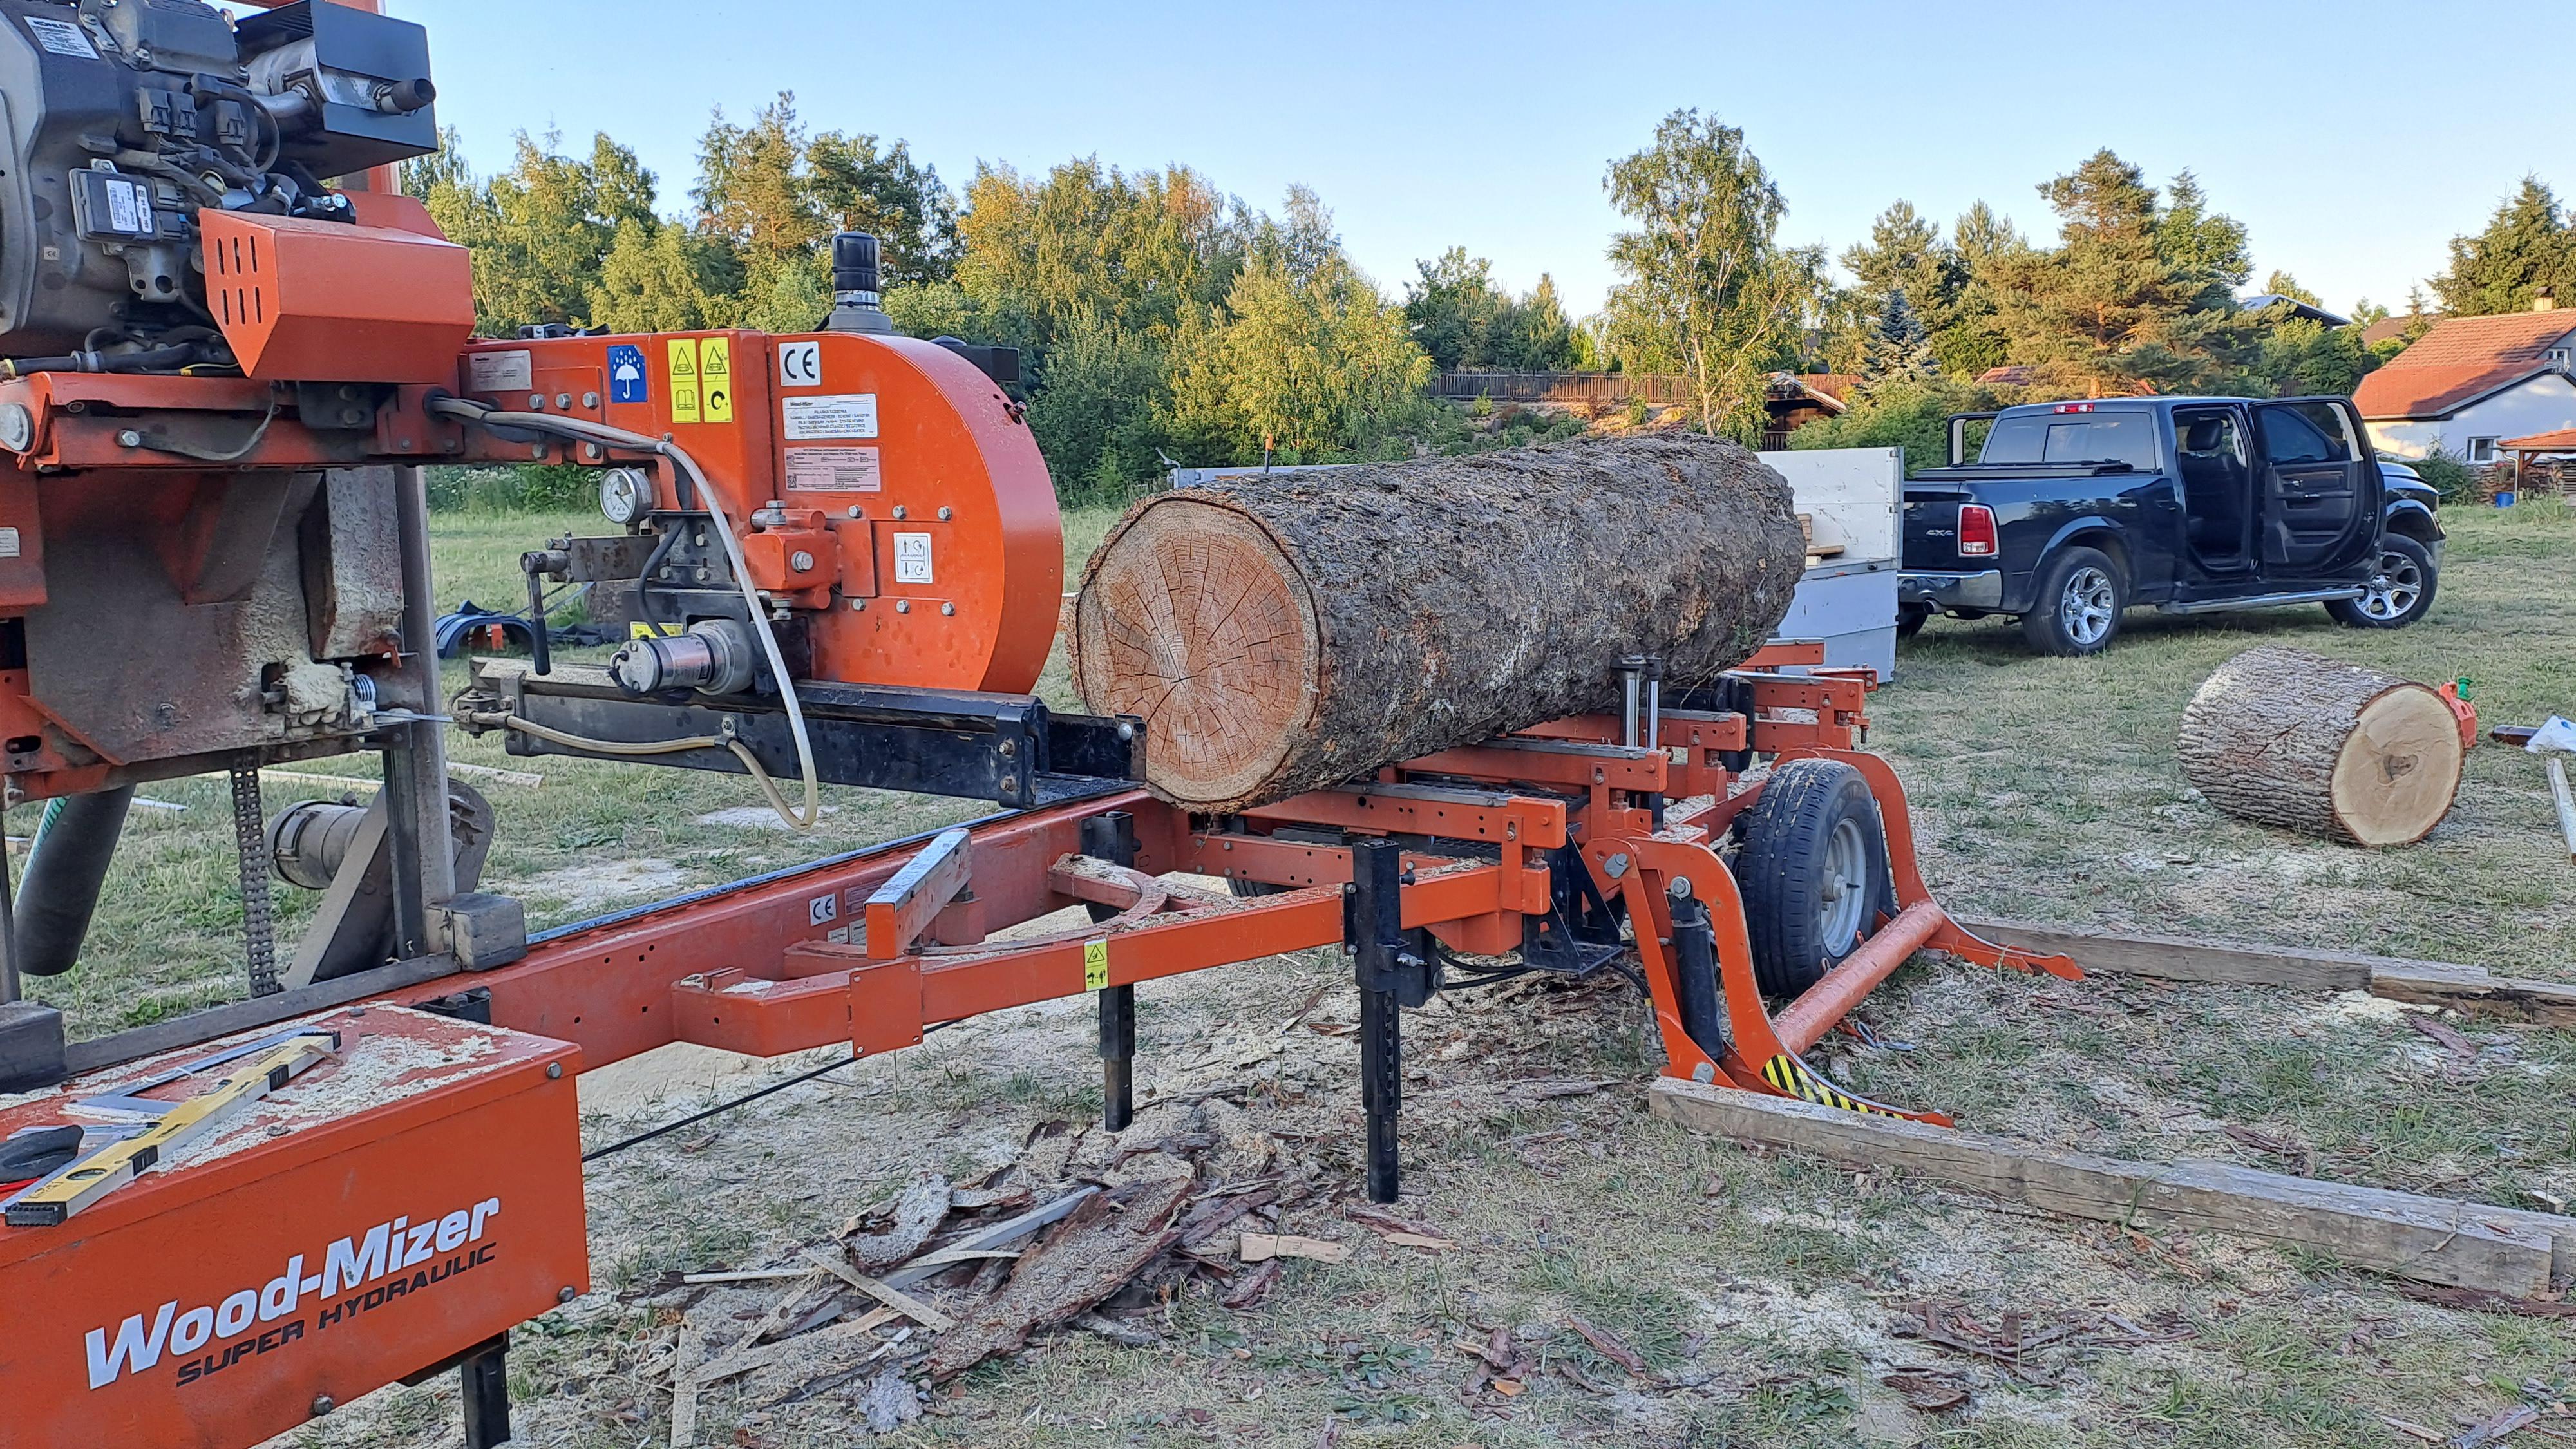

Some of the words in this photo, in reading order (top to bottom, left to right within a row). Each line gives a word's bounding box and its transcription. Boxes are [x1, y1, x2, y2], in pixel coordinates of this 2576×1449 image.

[784, 347, 816, 380] CE
[813, 898, 833, 920] CE
[84, 1197, 500, 1390] Wood-Mizer
[176, 1320, 305, 1387] SUPER
[318, 1242, 497, 1330] HYDRAULIC
